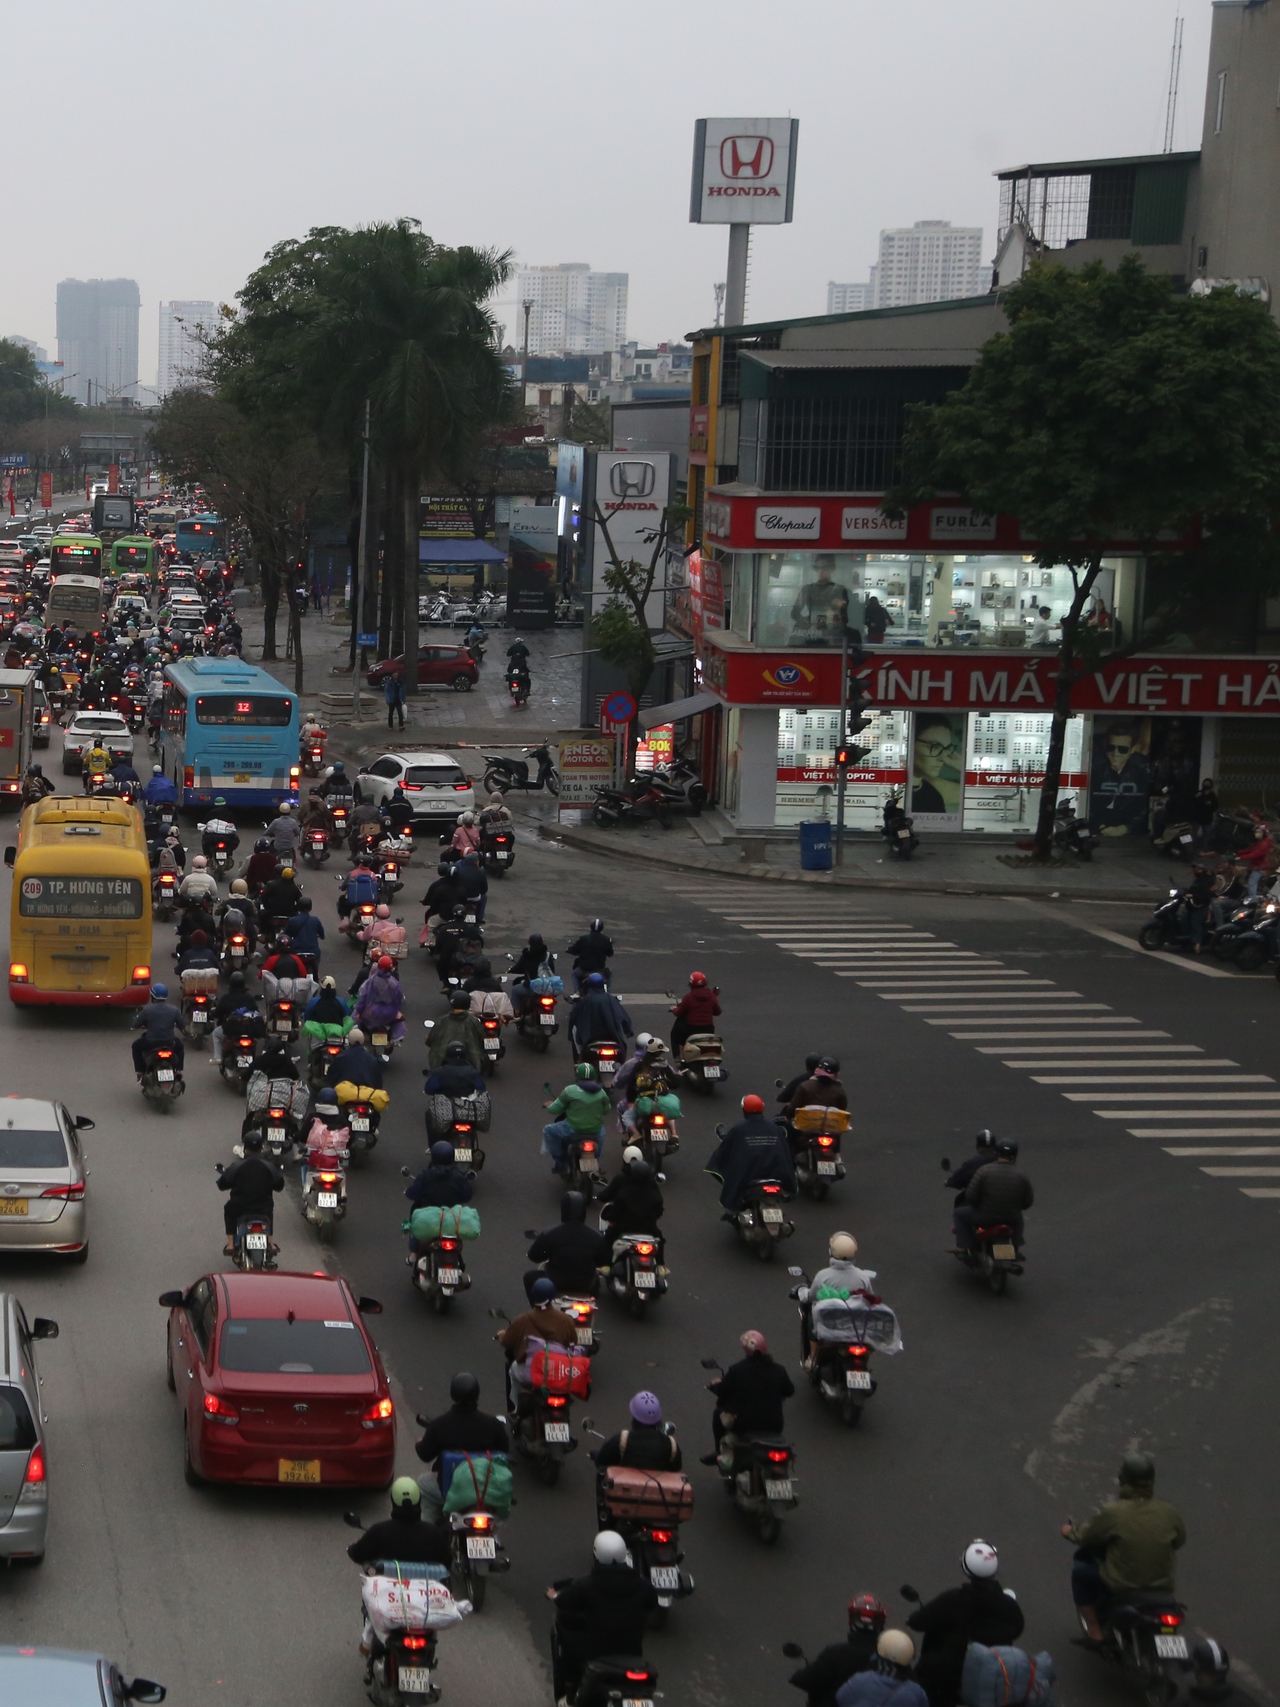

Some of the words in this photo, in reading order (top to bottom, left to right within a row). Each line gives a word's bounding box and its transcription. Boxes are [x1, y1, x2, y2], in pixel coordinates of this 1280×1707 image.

[707, 186, 781, 197] HONDA
[604, 502, 659, 511] HONDA
[759, 514, 817, 533] Chopard
[845, 517, 906, 530] VERSACE
[935, 515, 991, 528] FURLA
[779, 669, 797, 681] VH
[1093, 664, 1203, 711] VIỆT
[564, 744, 609, 755] ENEOS
[649, 740, 671, 751] 80k
[564, 755, 594, 763] MOTOR
[595, 755, 608, 763] OIL
[803, 770, 824, 781] VIỆT
[985, 774, 1006, 784] VIỆT
[562, 784, 571, 792] XE
[573, 784, 583, 792] GA
[912, 815, 958, 823] BVLGARI
[24, 883, 42, 894] 209
[49, 881, 67, 894] TP.
[69, 881, 104, 895] HƯNG
[107, 880, 132, 895] YÊN
[291, 1461, 308, 1471] 29E
[284, 1472, 316, 1482] 392.64
